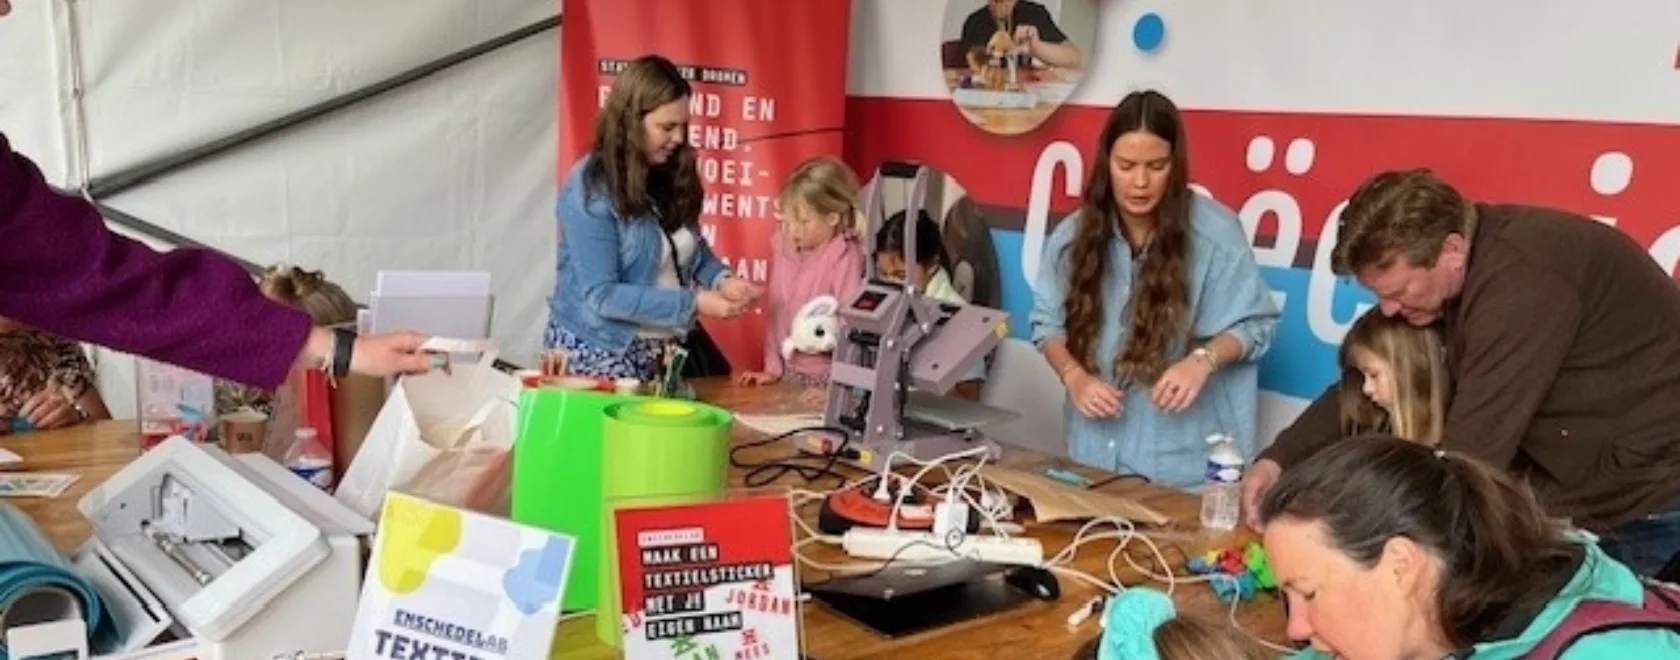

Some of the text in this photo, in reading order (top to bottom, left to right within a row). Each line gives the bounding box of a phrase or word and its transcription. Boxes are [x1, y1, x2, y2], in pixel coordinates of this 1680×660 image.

[742, 96, 774, 122] EN
[688, 124, 752, 152] END.
[703, 193, 783, 219] WENTS
[643, 548, 681, 564] MAAK
[645, 564, 773, 588] TEXTIELSTICKER
[725, 589, 790, 614] JORDAN
[393, 608, 508, 655] ENSCHEDELAB
[647, 613, 741, 639] EIGEN NAAM
